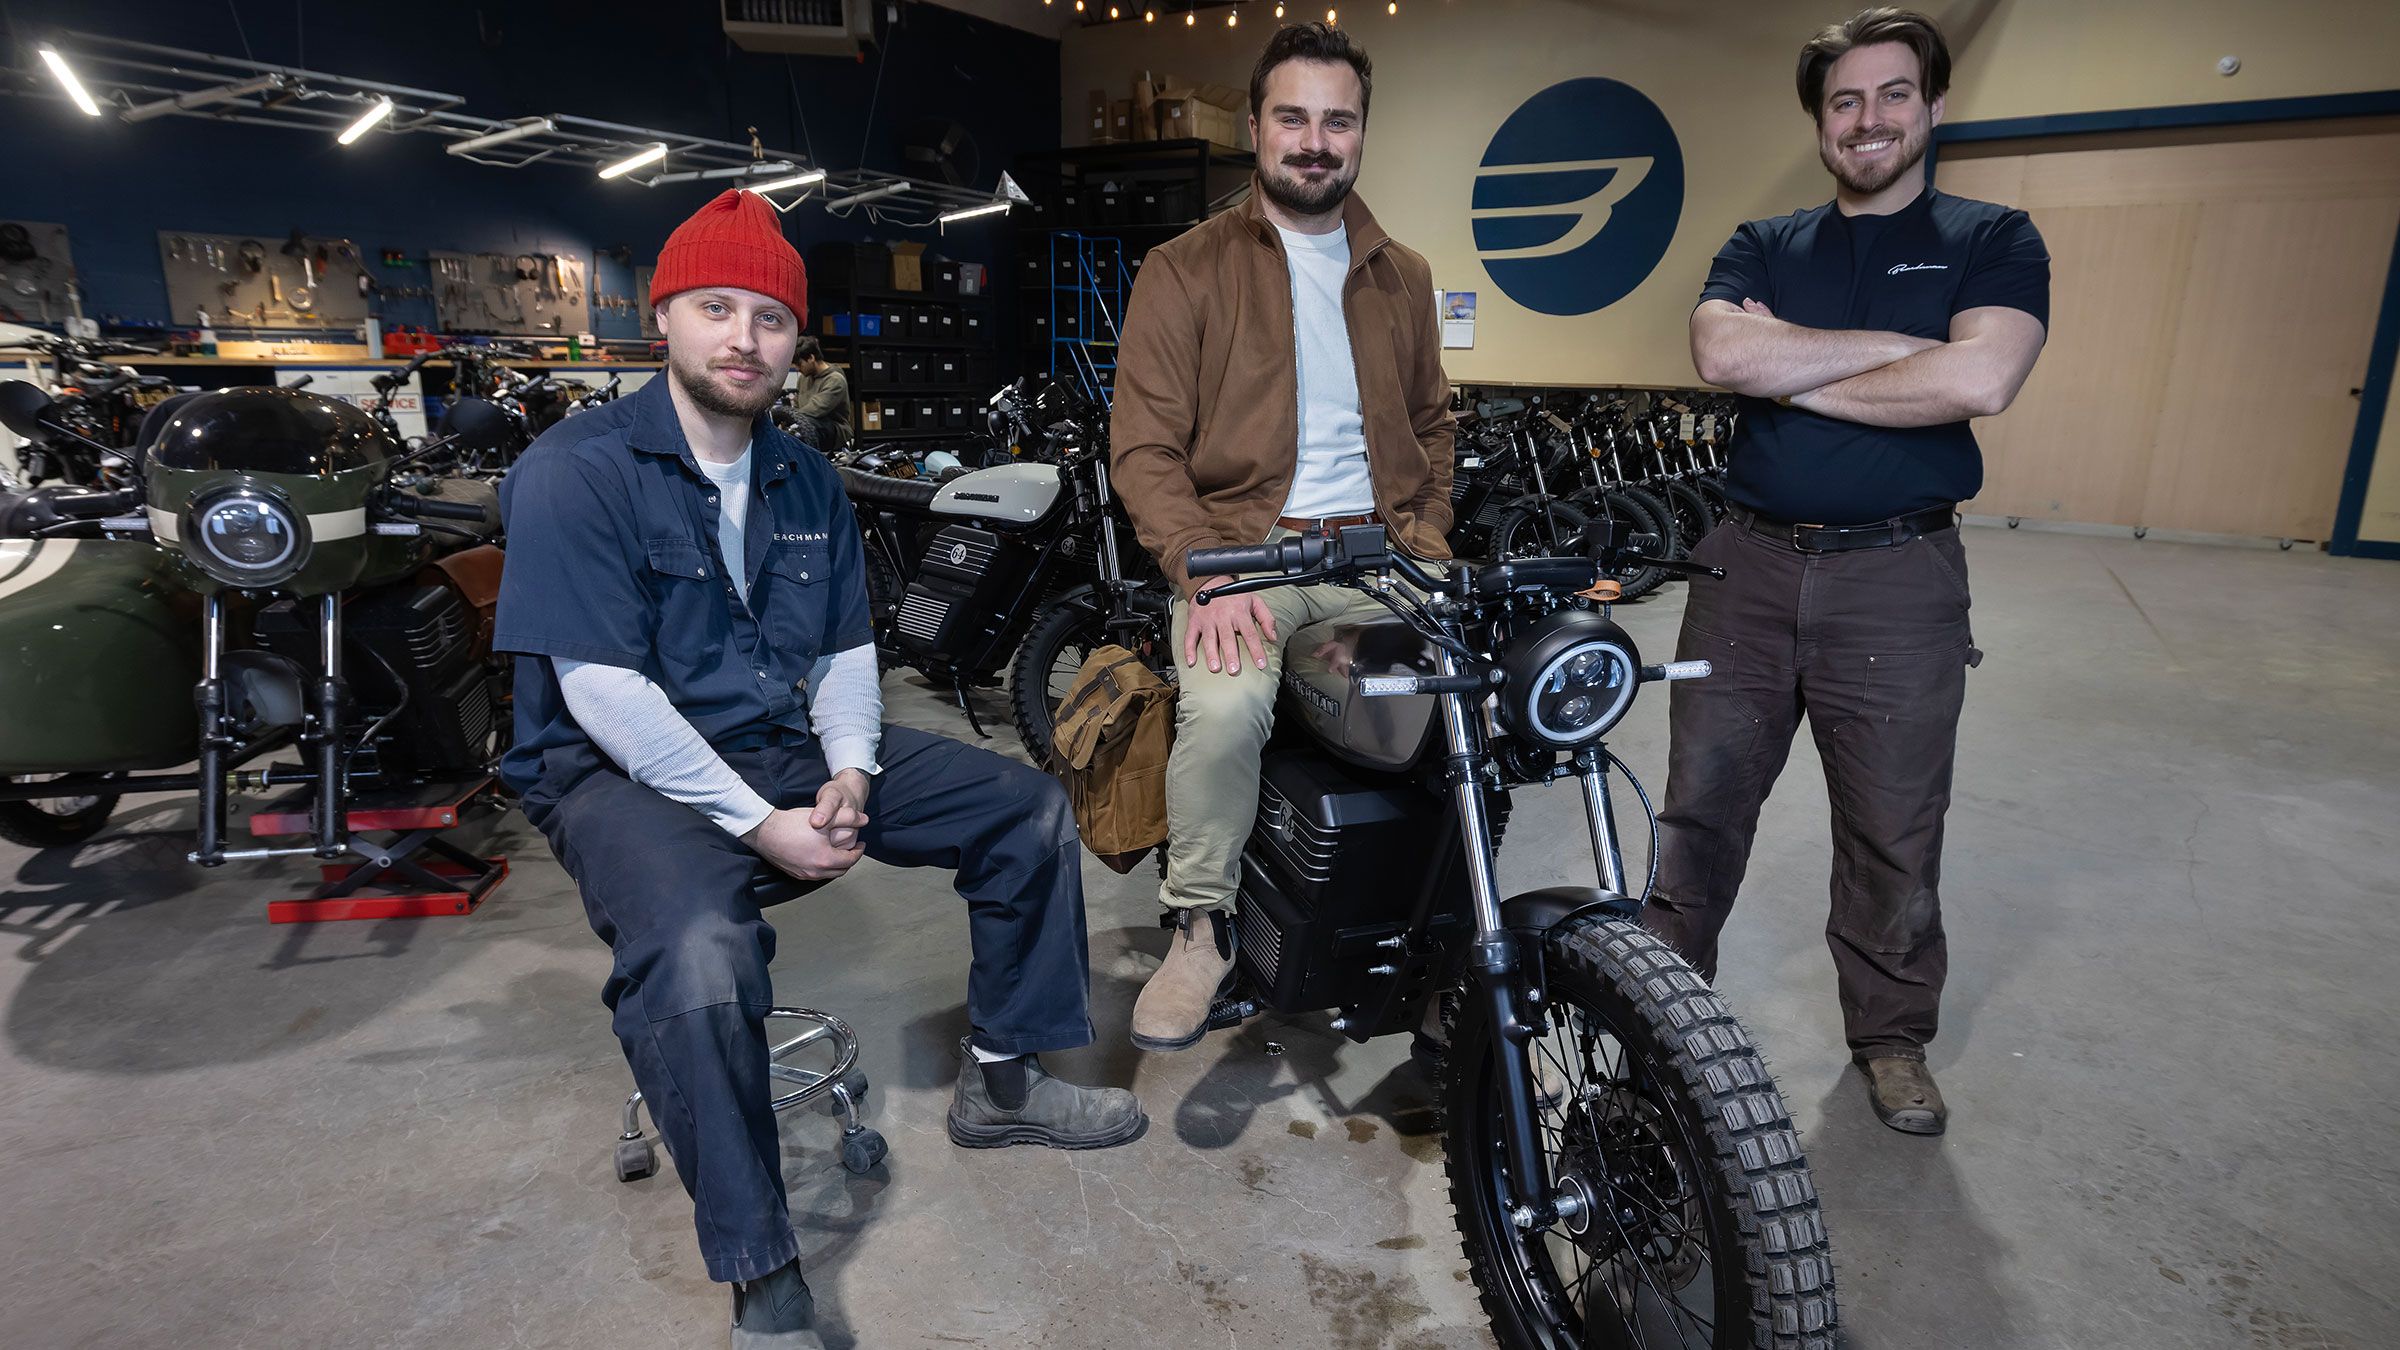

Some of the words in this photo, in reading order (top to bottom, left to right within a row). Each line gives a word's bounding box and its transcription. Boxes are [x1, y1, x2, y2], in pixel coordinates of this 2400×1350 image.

[773, 532, 829, 541] EACHMAN
[1063, 539, 1074, 551] 64
[952, 547, 964, 560] 64
[1281, 806, 1294, 834] 64
